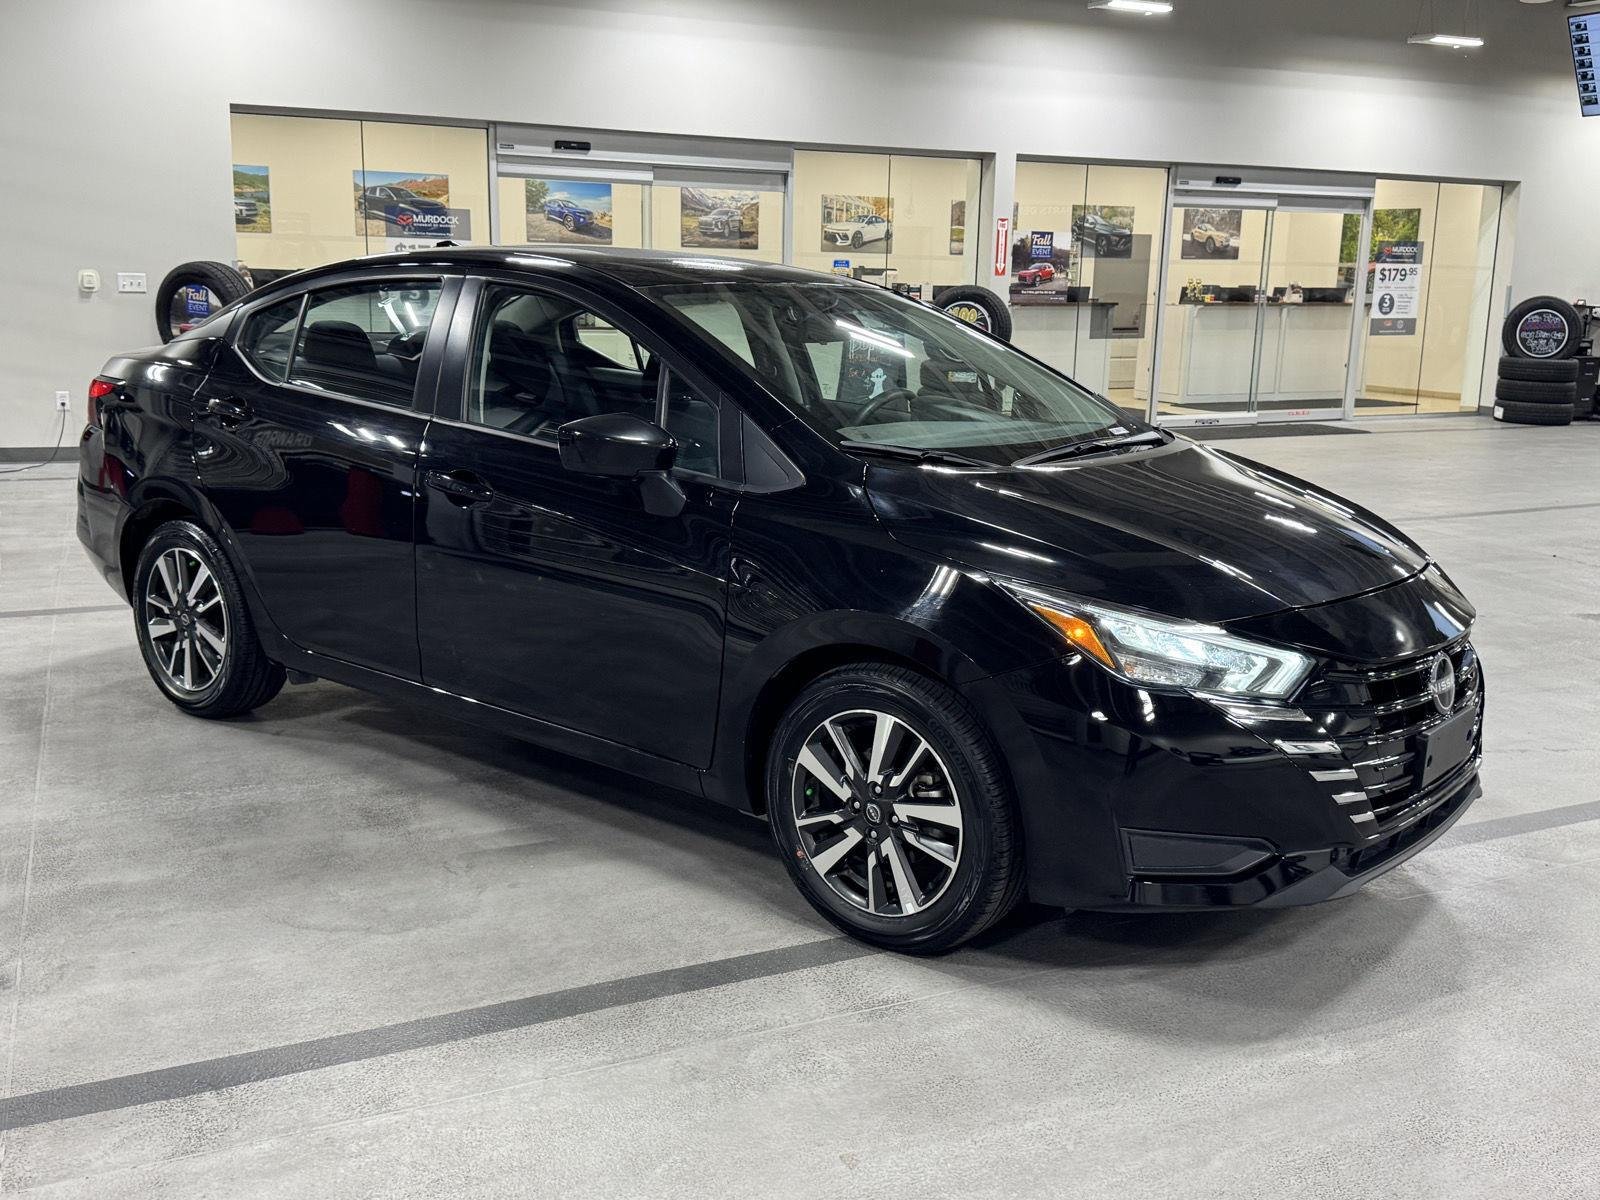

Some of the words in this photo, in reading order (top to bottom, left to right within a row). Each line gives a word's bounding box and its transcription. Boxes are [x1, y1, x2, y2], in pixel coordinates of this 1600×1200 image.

[413, 215, 459, 224] MURDOCK
[1032, 234, 1051, 245] Fall
[187, 288, 207, 301] Fall
[1383, 294, 1391, 308] 3
[188, 304, 208, 312] EVENT
[1430, 677, 1453, 693] NISS
